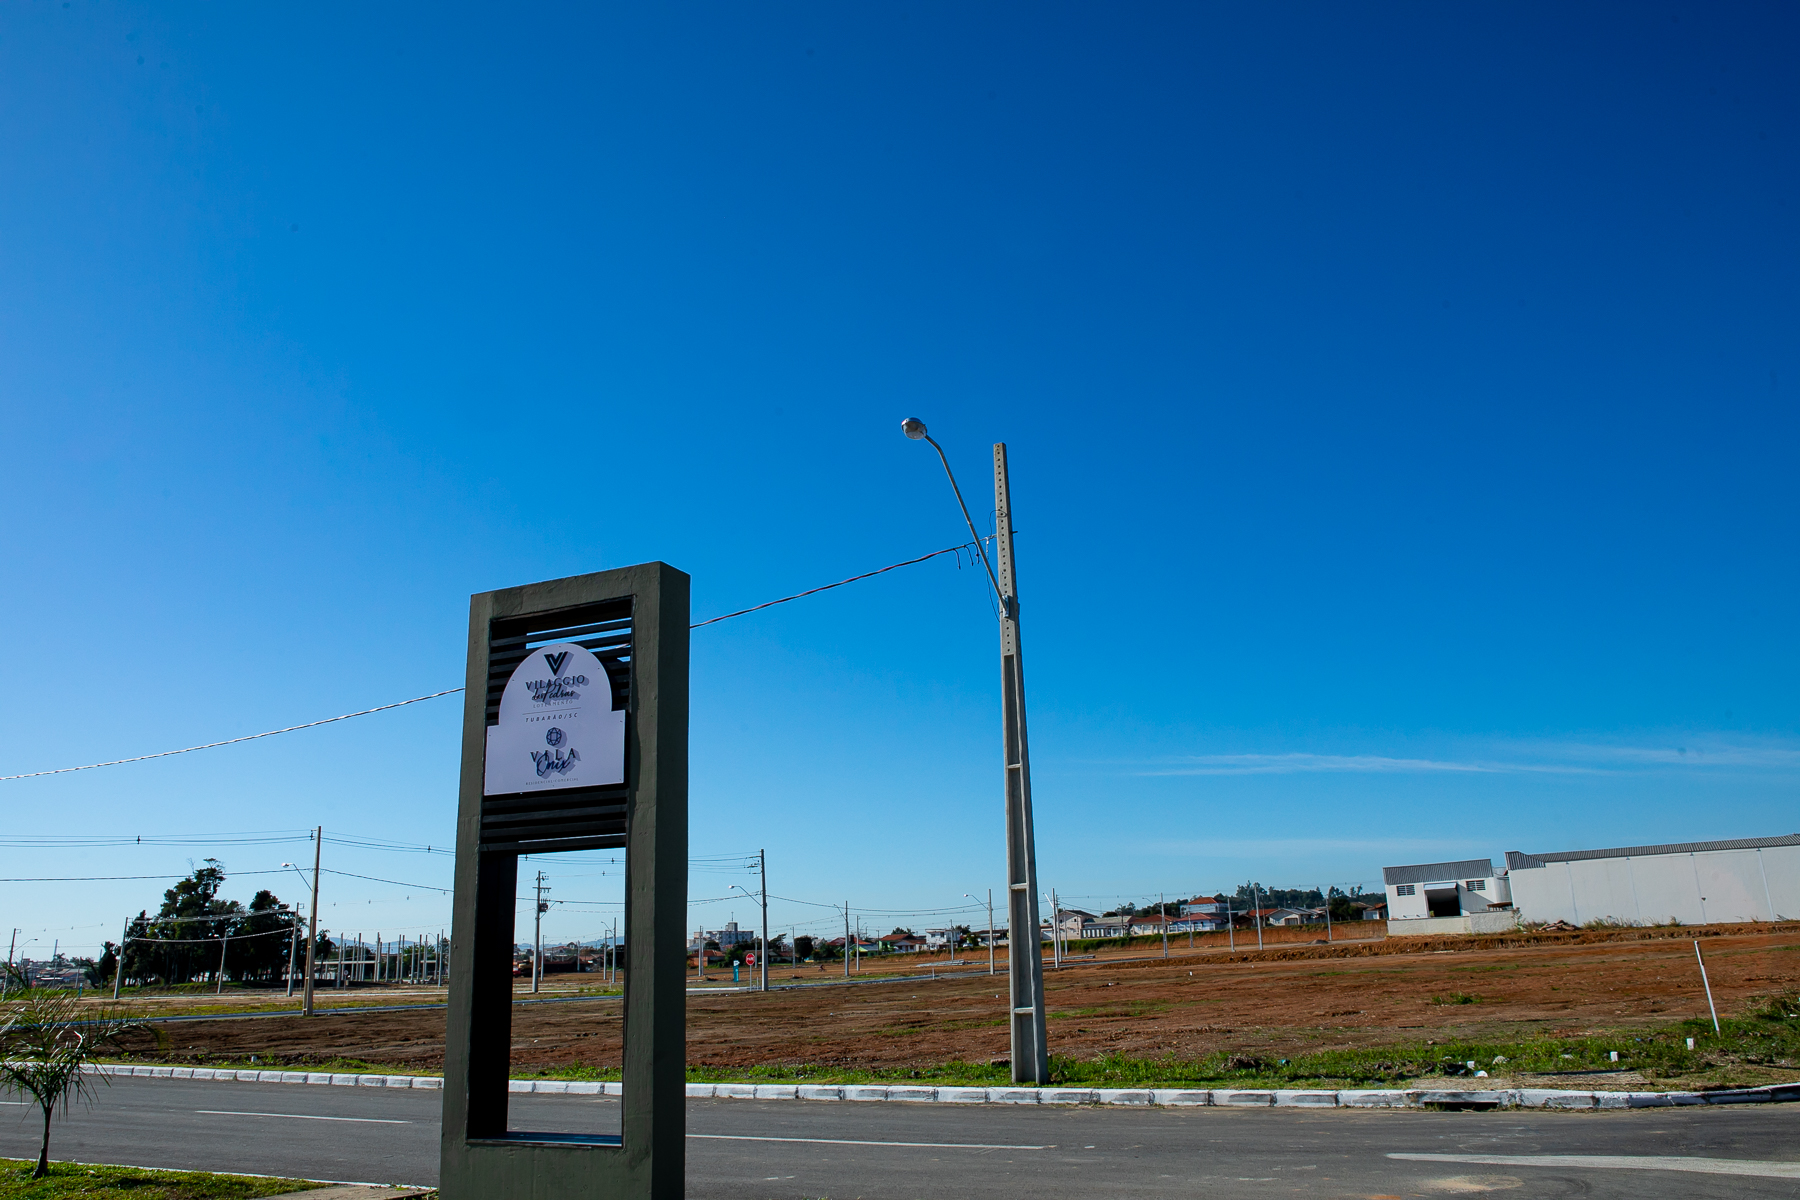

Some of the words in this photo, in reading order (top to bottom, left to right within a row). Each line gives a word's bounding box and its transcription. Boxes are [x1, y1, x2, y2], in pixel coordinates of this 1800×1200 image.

[525, 674, 585, 690] VILAGGIO
[532, 700, 574, 709] LOTEAMENTO
[530, 747, 576, 763] VILA
